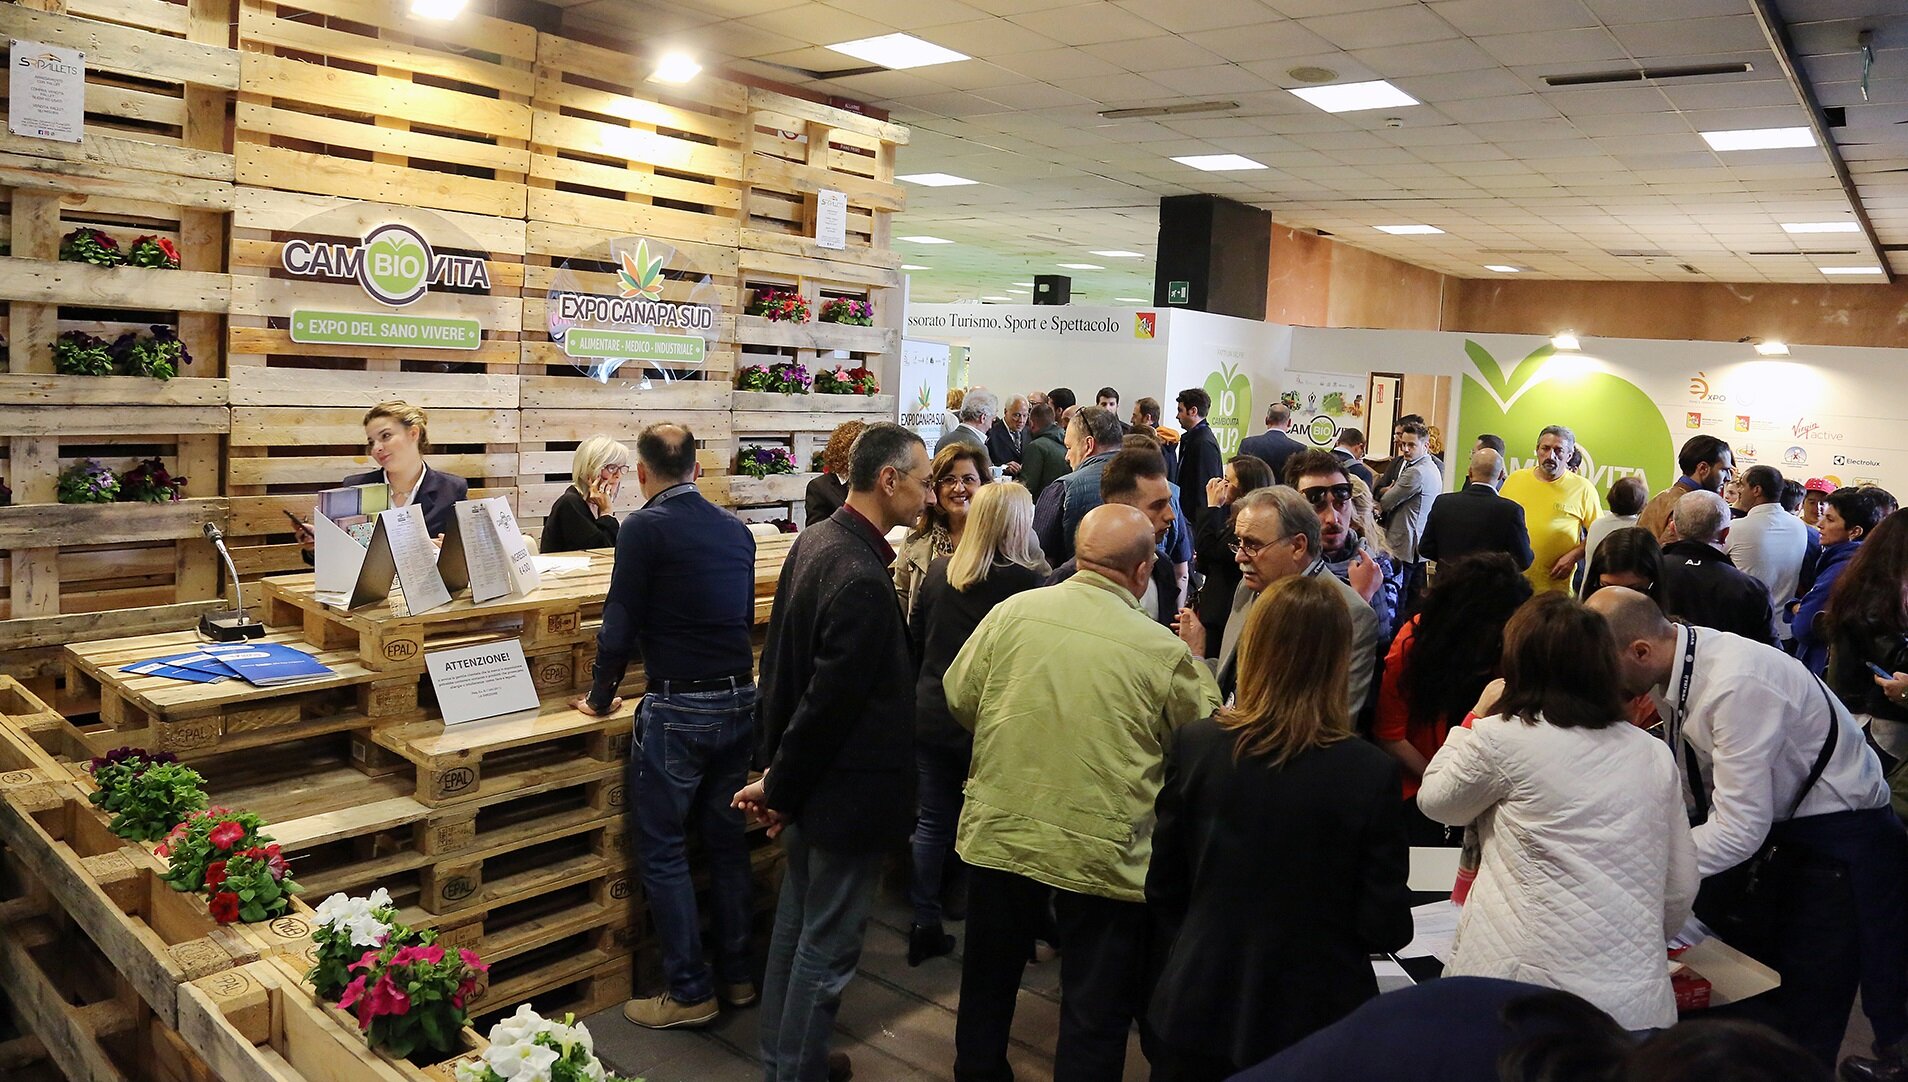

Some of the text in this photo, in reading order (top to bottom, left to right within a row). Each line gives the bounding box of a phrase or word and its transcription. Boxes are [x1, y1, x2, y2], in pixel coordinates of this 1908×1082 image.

[561, 296, 712, 328] EXPO CANAPA SUD
[309, 319, 466, 341] EXPO DEL SANO VIVERE
[1004, 314, 1037, 333] Sport
[1040, 319, 1048, 330] e
[1051, 315, 1120, 337] Spettacolo
[579, 337, 694, 356] ALIMENTARE MEDICO INDUSTRIALE
[1219, 390, 1236, 417] IO
[1792, 418, 1820, 440] Virgin
[1810, 431, 1844, 441] active
[1847, 458, 1880, 467] Electrolux
[388, 644, 413, 658] EPAL
[445, 652, 511, 671] ATTENZIONE!
[444, 771, 468, 789] EPAL
[448, 883, 472, 897] EPAL
